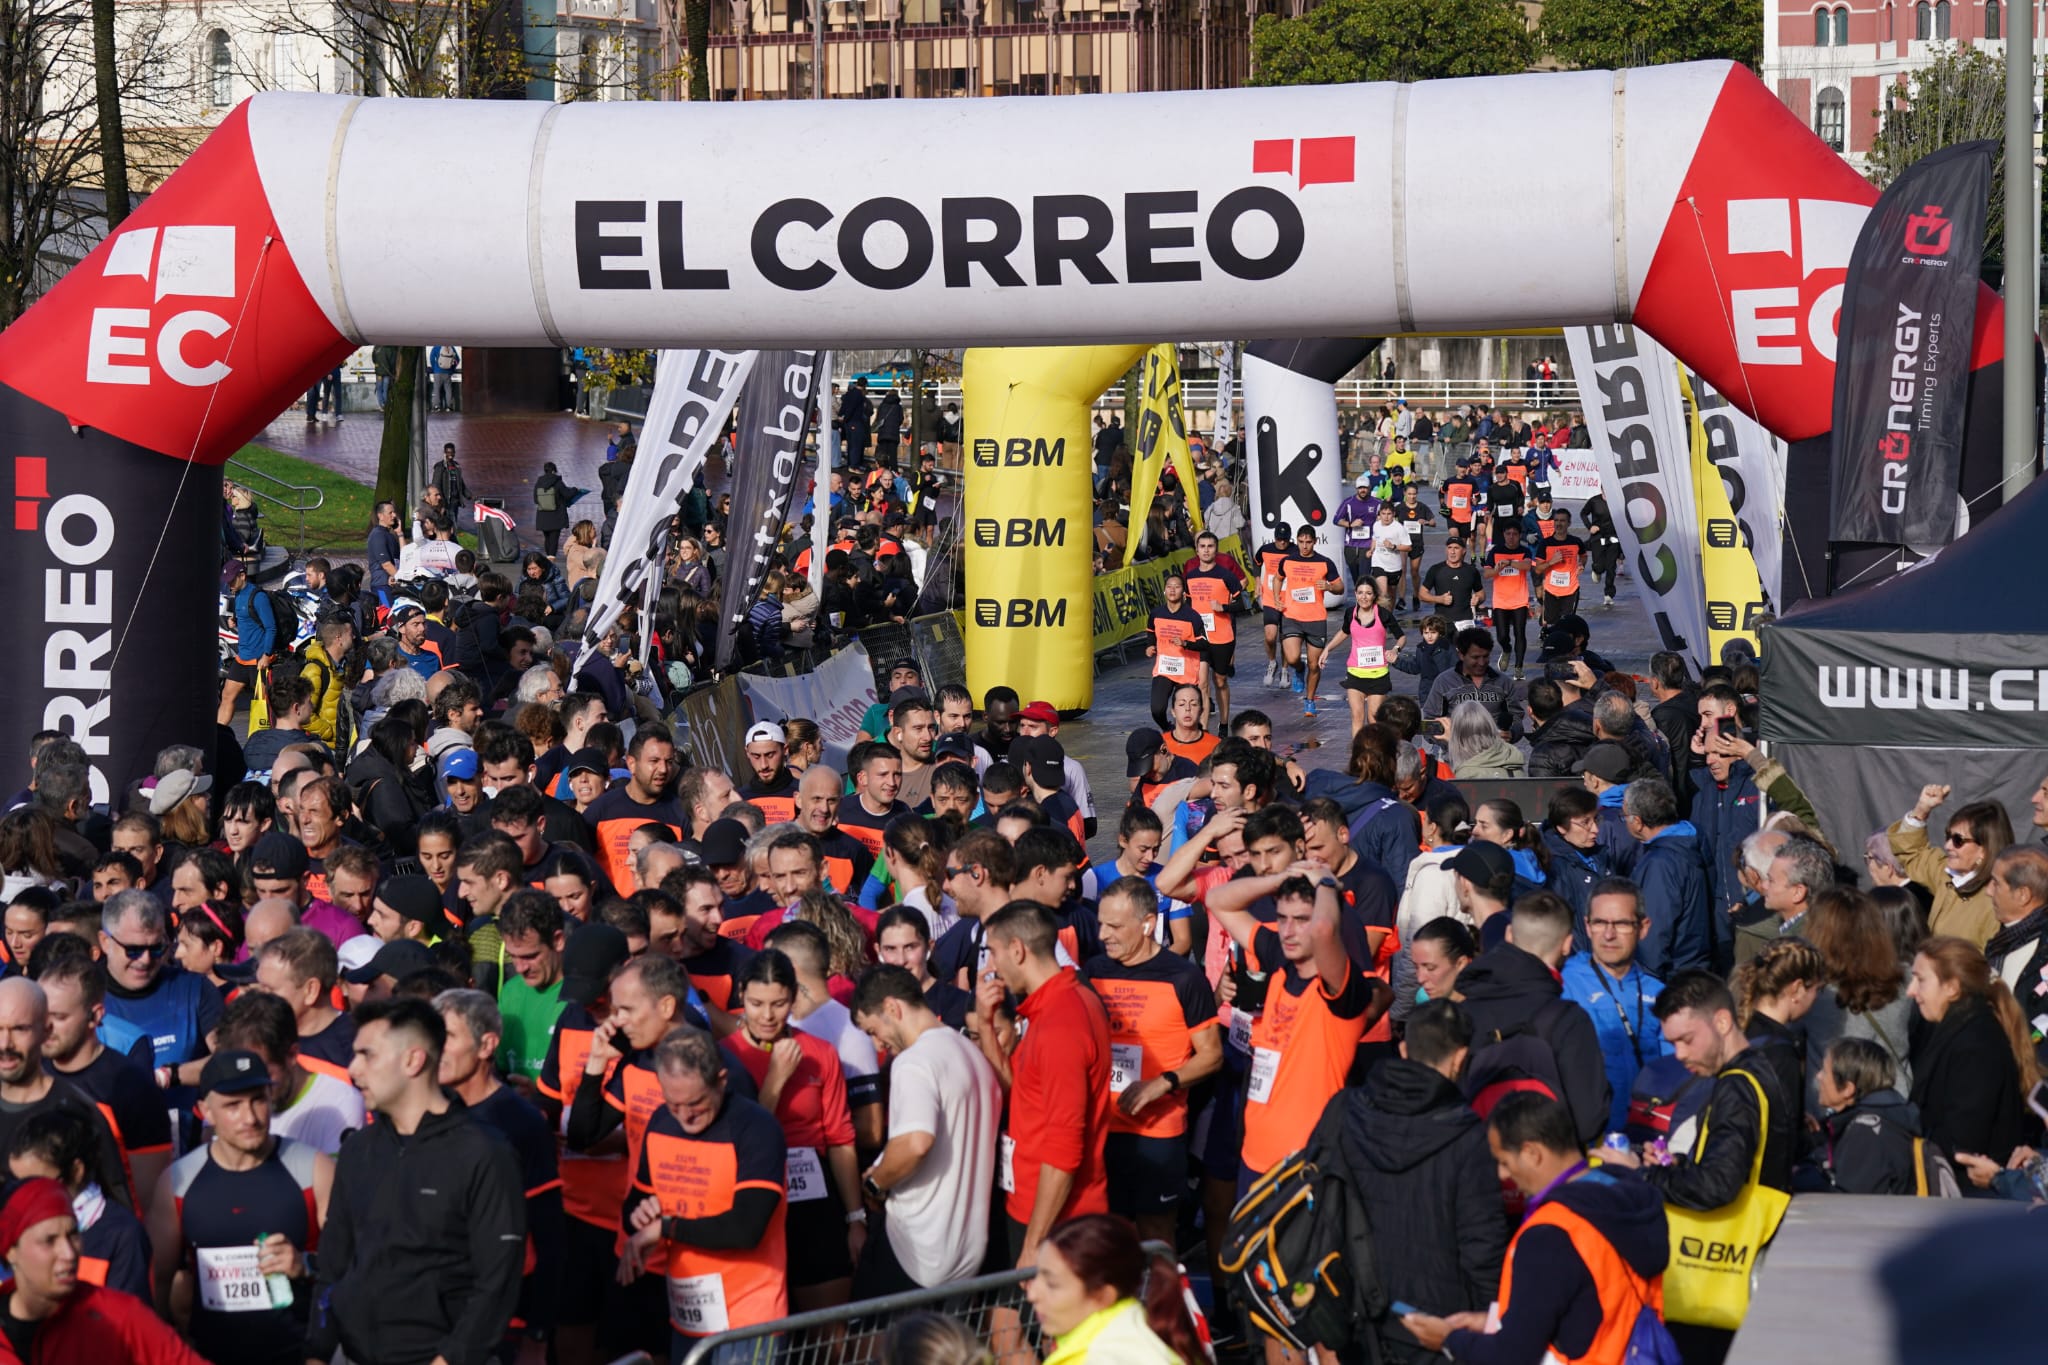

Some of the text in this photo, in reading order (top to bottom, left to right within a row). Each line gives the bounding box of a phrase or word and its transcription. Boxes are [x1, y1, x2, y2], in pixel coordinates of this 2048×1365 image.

[574, 185, 1306, 291] EL CORREO
[86, 306, 233, 387] EC
[1917, 312, 1941, 432] Timing Experts
[1004, 437, 1066, 467] BM
[1004, 518, 1066, 547] BM
[1005, 598, 1067, 627] BM
[1705, 1241, 1748, 1265] BM
[224, 1281, 261, 1299] 1280
